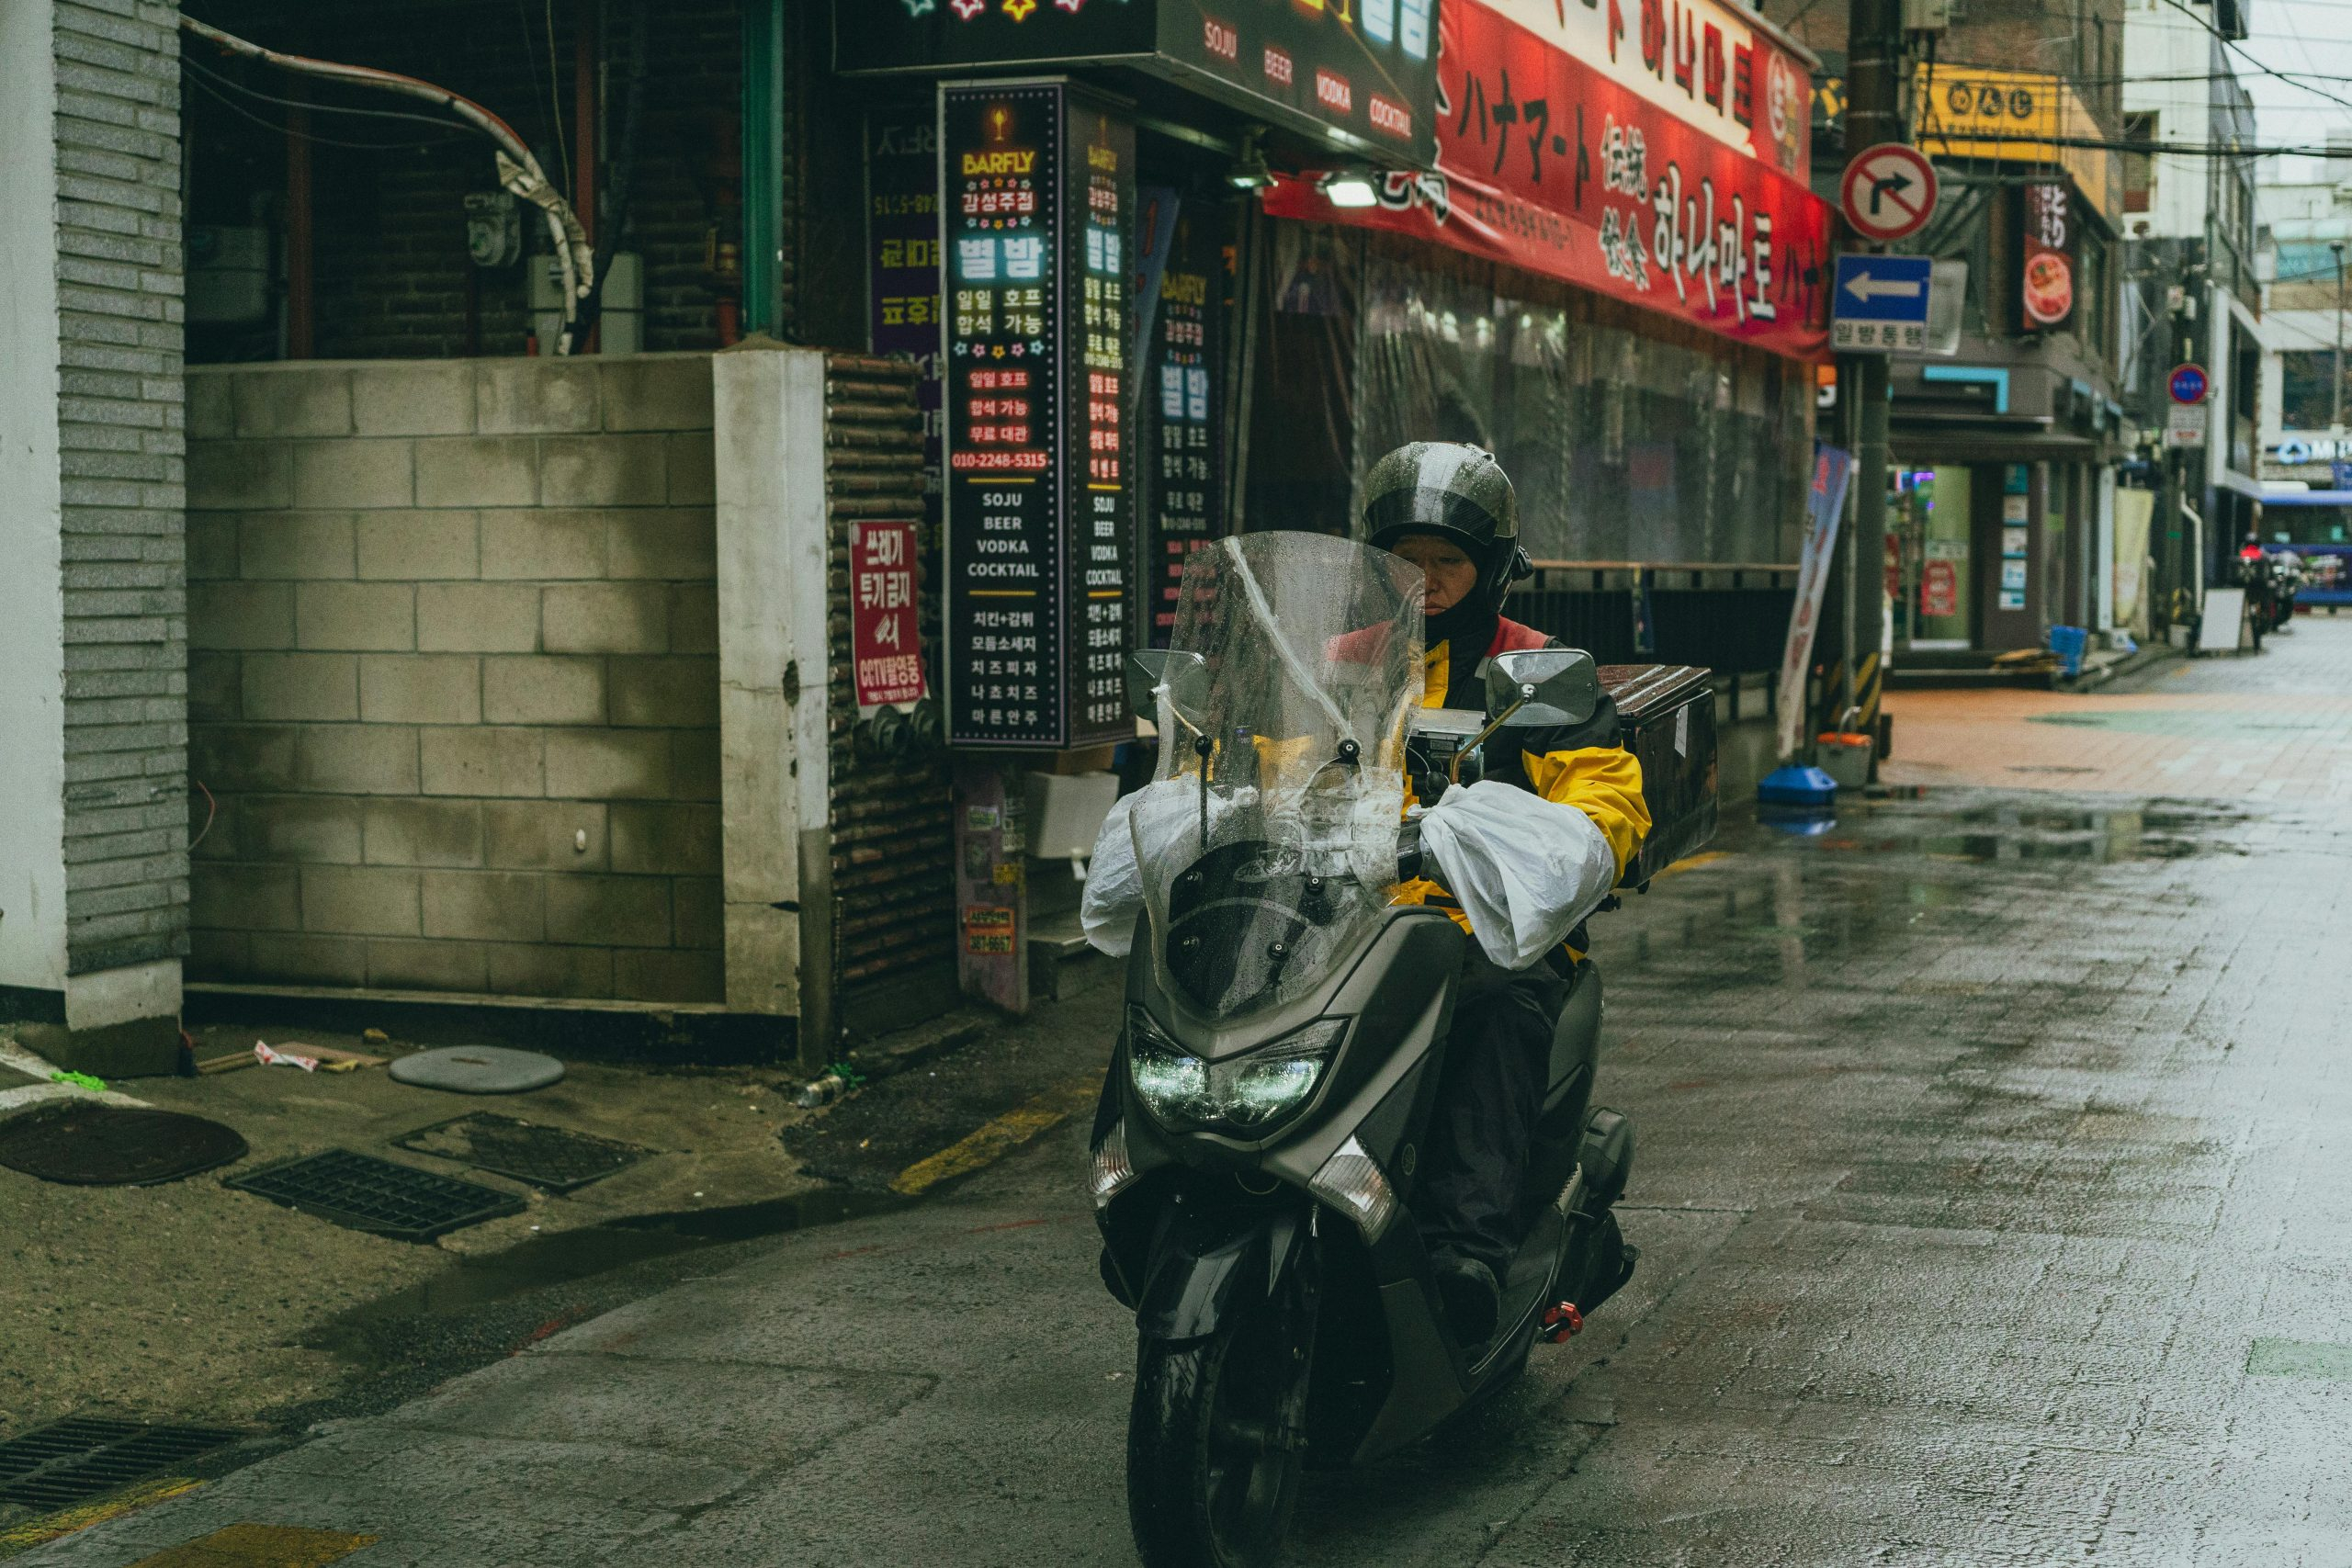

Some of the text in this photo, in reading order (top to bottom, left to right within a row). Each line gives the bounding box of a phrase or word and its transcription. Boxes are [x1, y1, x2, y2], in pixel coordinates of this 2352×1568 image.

[1204, 20, 1412, 138] SOJU BEER VODKA COCKTAIL
[1457, 68, 1590, 212] ハナマート
[962, 151, 1035, 175] BARFLY
[961, 191, 1034, 212] 감성주점
[958, 237, 1043, 278] 별밤
[956, 288, 1042, 310] 일일 호프
[956, 314, 1042, 335] 합석 가능
[969, 371, 1027, 388] 일일 호프
[969, 400, 1028, 416] 합석 가능
[969, 426, 1028, 442] 무료 대관
[952, 454, 1046, 468] 010-2248-5315
[982, 492, 1023, 506] SOJU
[1093, 496, 1114, 513] SOJU
[983, 517, 1023, 530] BEER
[1093, 521, 1114, 537] BEER
[866, 530, 903, 566] 쓰레기
[977, 540, 1029, 553] VODKA
[1091, 545, 1118, 561] VODKA
[967, 563, 1039, 577] COCKTAIL
[1085, 569, 1123, 585] COCKTAIL
[860, 571, 910, 610] 투기금지
[860, 654, 920, 688] CCTV촬영중
